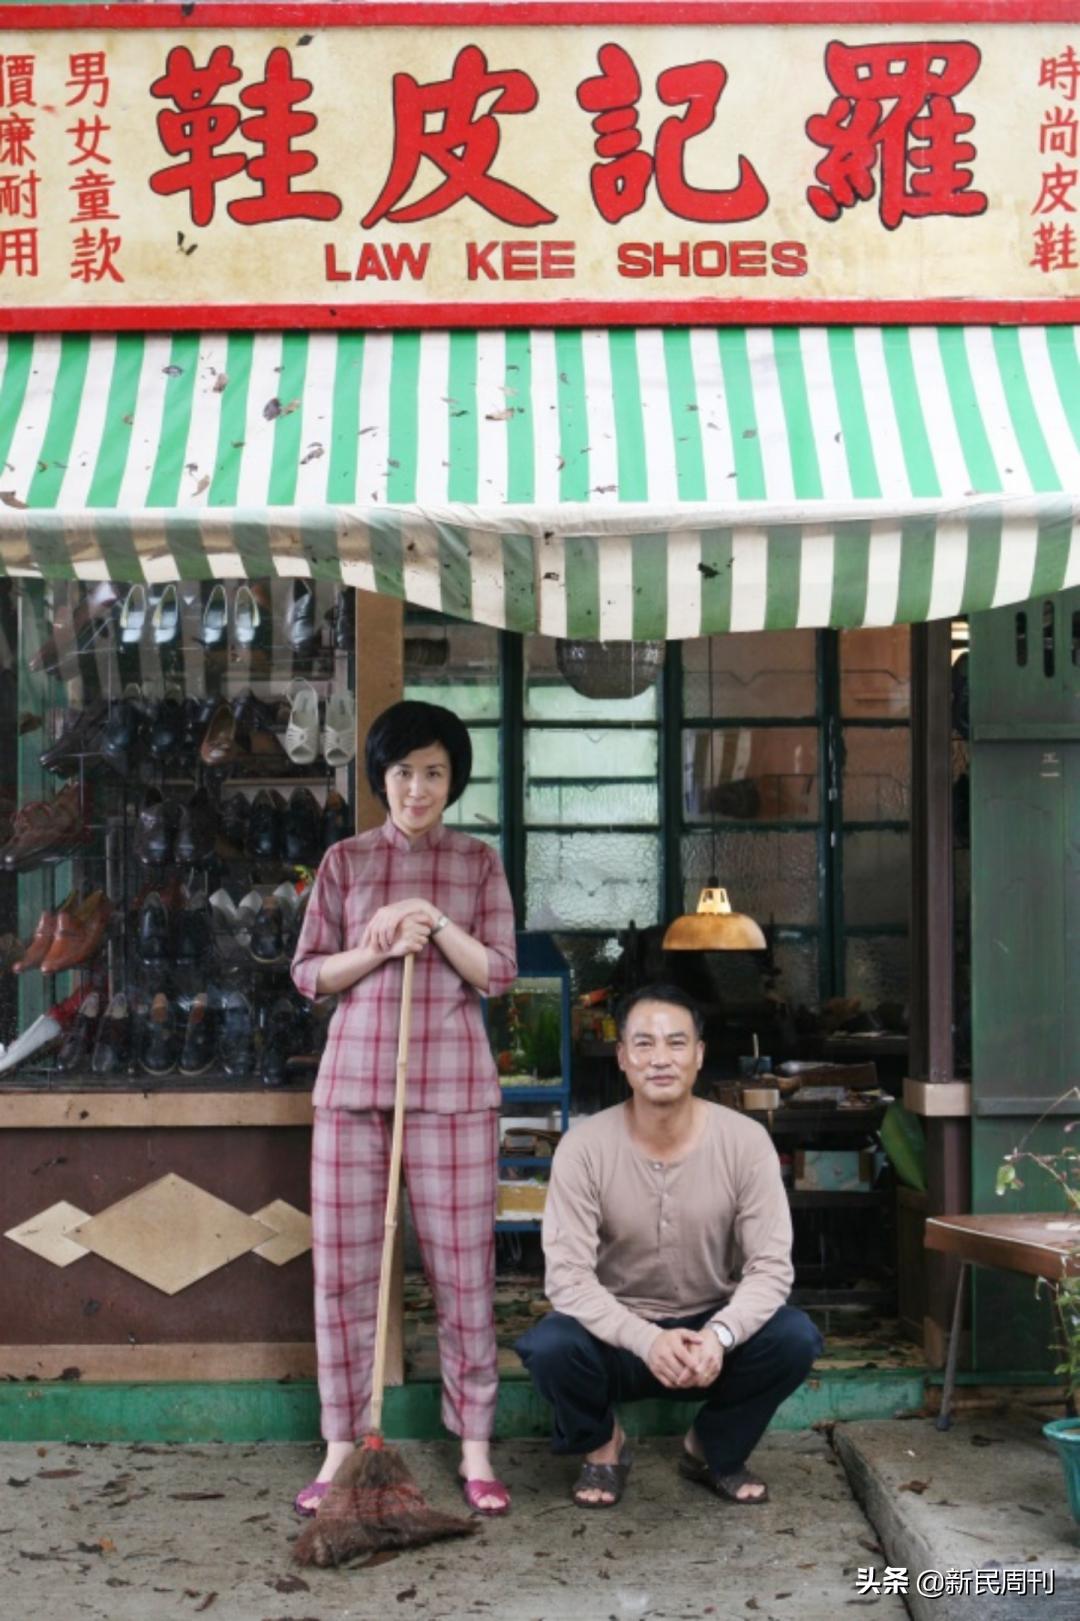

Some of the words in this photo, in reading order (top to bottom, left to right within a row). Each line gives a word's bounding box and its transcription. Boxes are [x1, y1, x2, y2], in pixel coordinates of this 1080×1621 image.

[0, 54, 42, 277] 價廉耐用
[65, 51, 124, 283] 男女童款
[325, 243, 429, 281] LAW
[467, 241, 575, 280] KEE
[618, 241, 808, 278] SHOES
[1029, 46, 1080, 272] 時尚皮鞋
